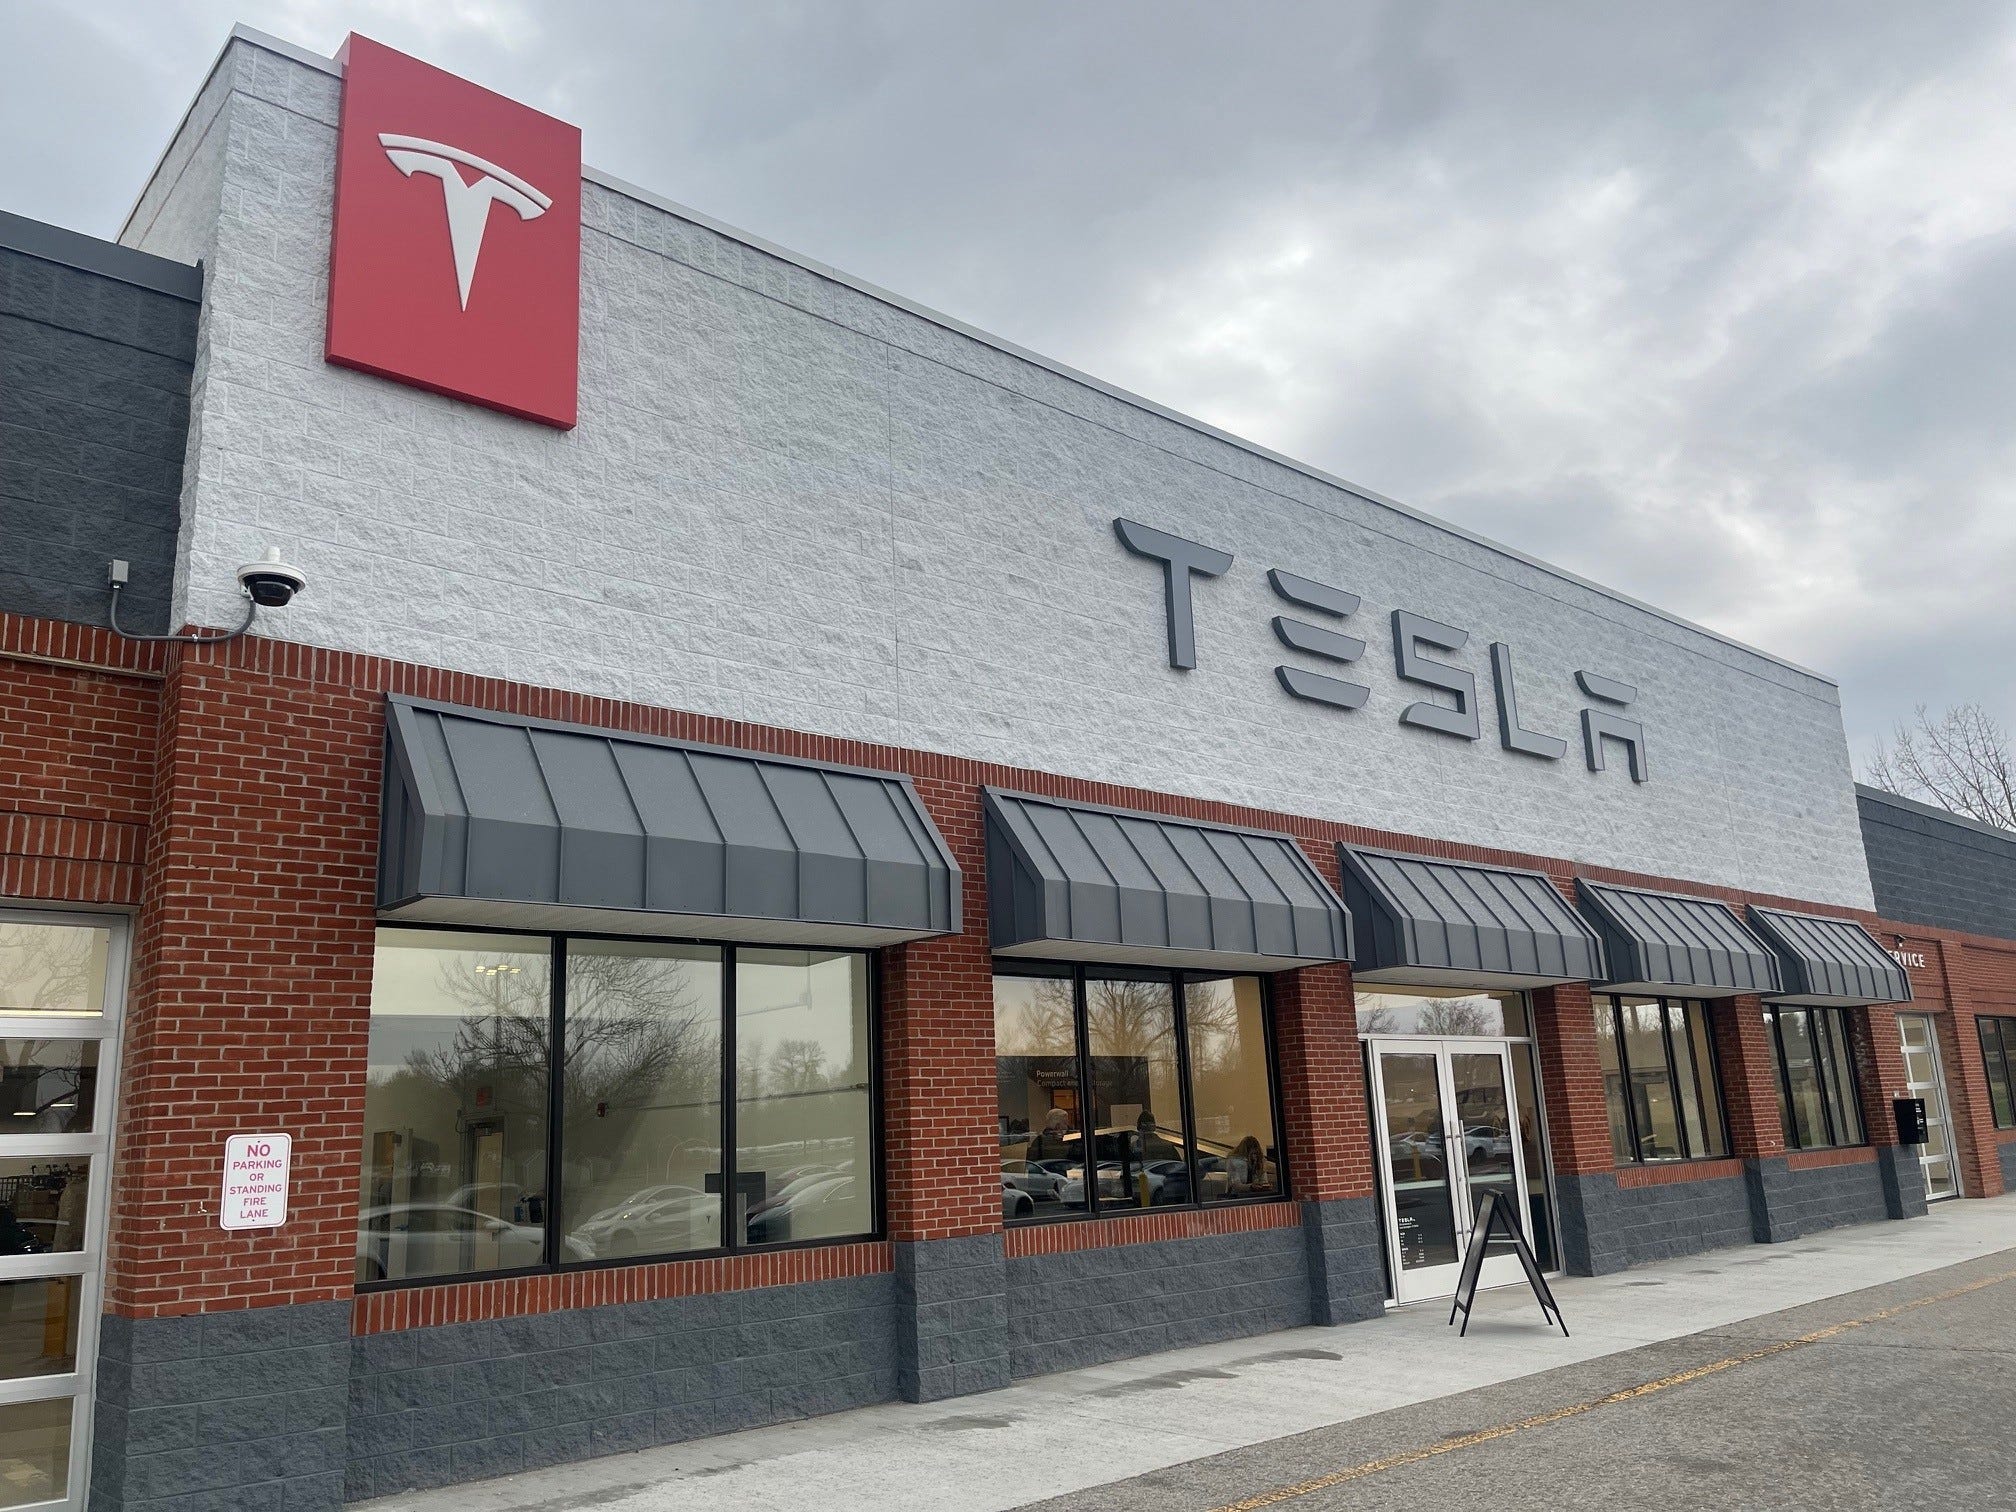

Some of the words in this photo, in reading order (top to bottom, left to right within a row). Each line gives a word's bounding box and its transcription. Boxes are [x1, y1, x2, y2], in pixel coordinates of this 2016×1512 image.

[1112, 516, 1649, 784] TESLA
[1036, 1070, 1069, 1078] Powerwall
[246, 1144, 271, 1158] NO
[232, 1159, 283, 1170] PARKING
[249, 1172, 265, 1182] OR
[229, 1184, 282, 1195] STANDING
[243, 1196, 267, 1206] FIRE
[240, 1208, 269, 1219] LANE
